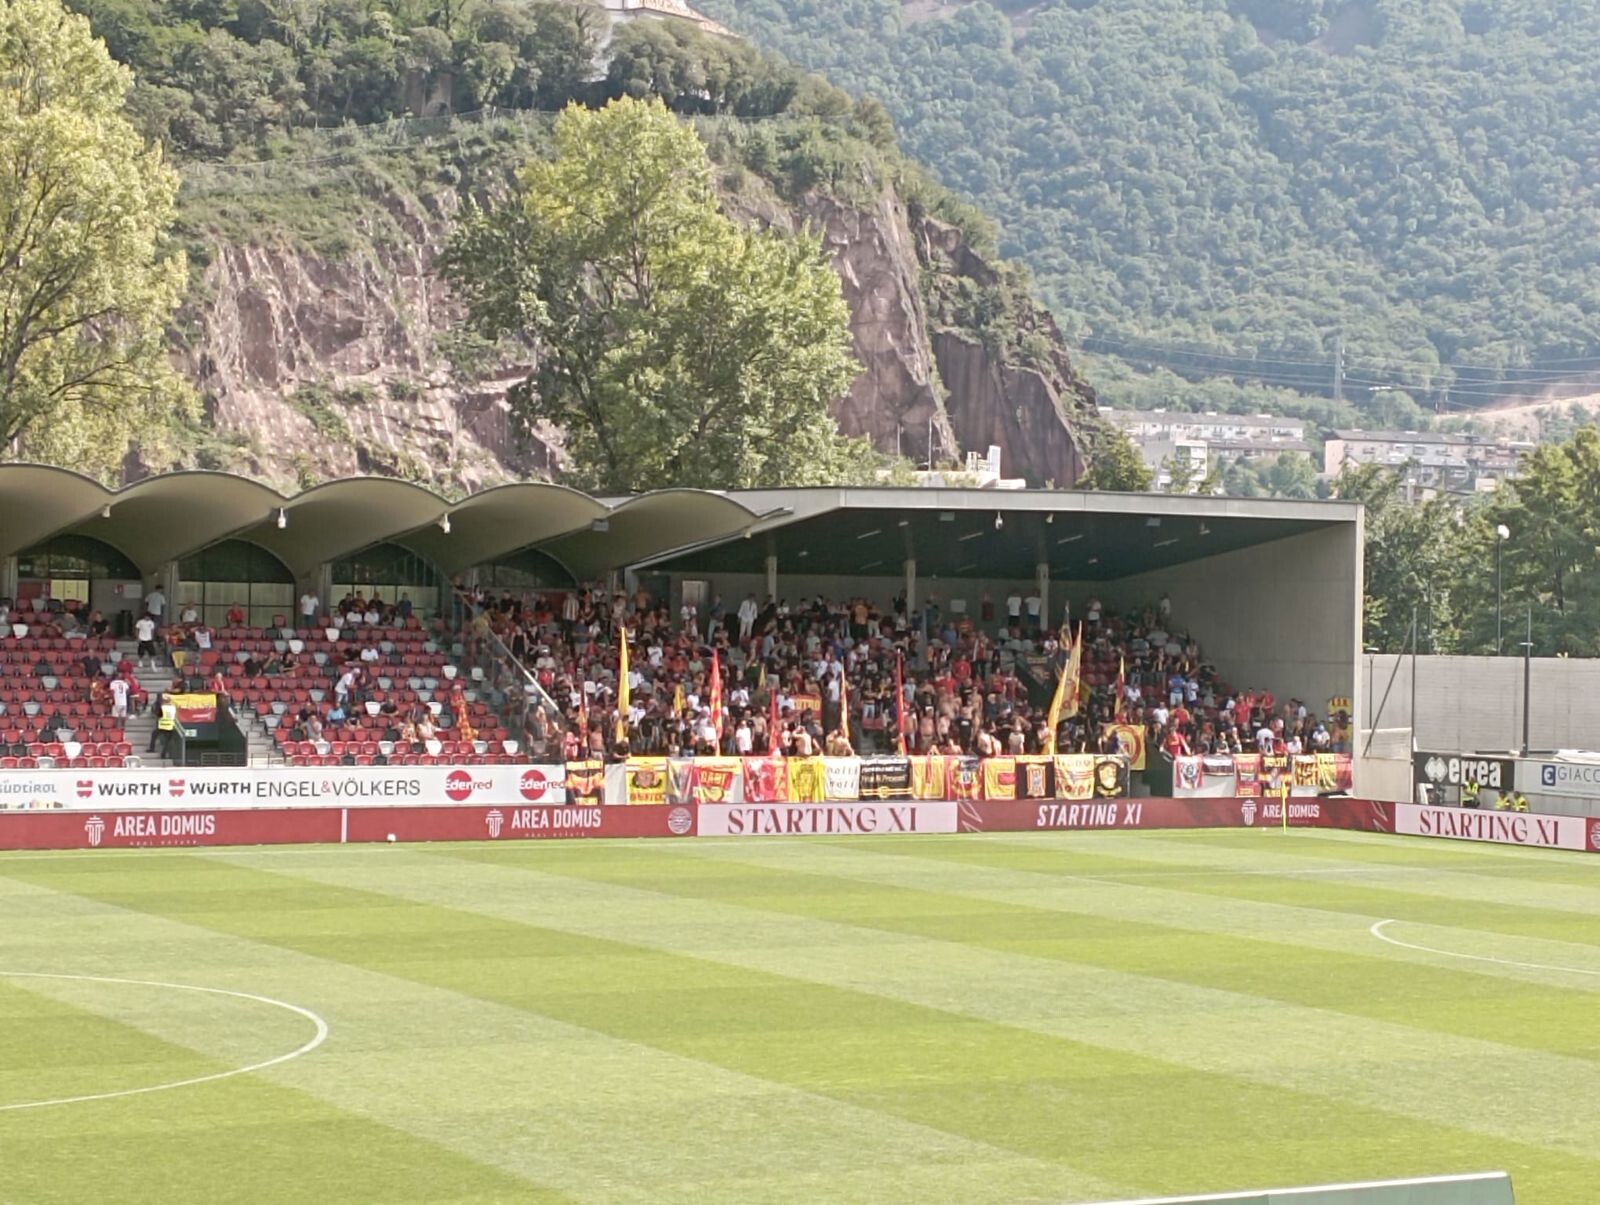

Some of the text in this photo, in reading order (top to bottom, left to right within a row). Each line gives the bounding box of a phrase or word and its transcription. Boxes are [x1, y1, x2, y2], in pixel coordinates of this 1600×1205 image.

[98, 783, 161, 795] WÜRTH
[190, 782, 250, 795] WÜRTH
[445, 779, 492, 791] Edenred
[511, 809, 601, 829] AREA DOMUS
[727, 807, 917, 835] STARTING XI
[1037, 803, 1142, 826] STARTING XI
[1288, 804, 1320, 818] DOMUS
[114, 814, 215, 836] AREA DOMUS
[1419, 810, 1559, 846] STARTING XI
